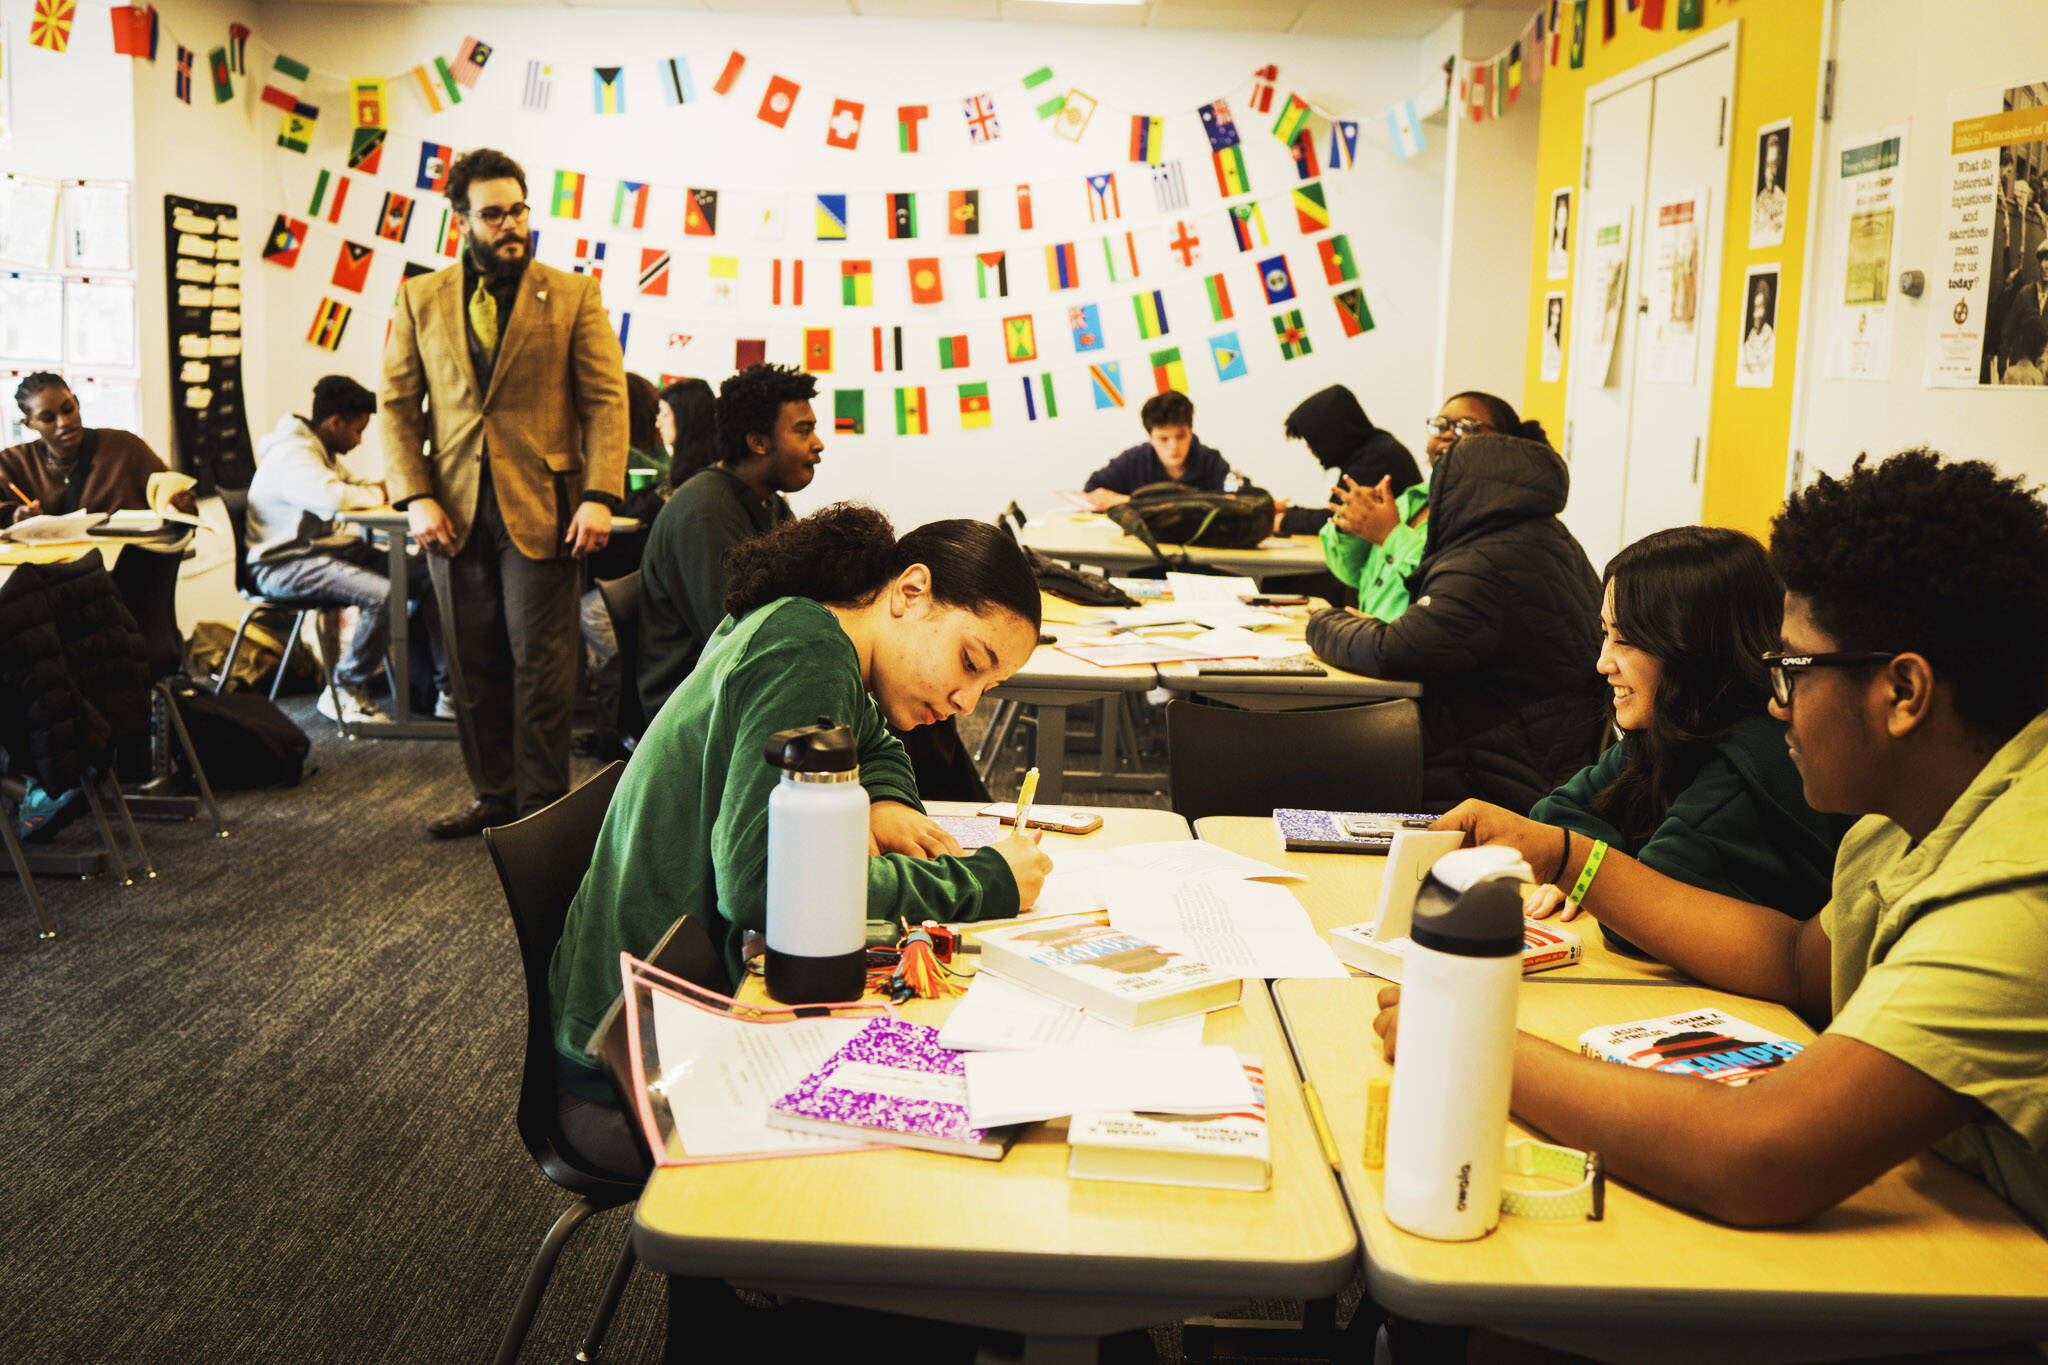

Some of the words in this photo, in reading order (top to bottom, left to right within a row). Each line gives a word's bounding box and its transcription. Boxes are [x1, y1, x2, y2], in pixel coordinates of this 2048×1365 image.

[1958, 160, 1978, 172] What
[1981, 158, 1991, 169] do
[1953, 174, 1992, 191] historical
[1951, 194, 1992, 210] injustices
[1962, 210, 1977, 222] and
[1948, 227, 1988, 241] sacrifices
[1954, 246, 1978, 257] mean
[1953, 261, 1965, 273] for
[1968, 262, 1977, 272] us
[1782, 657, 1813, 666] OAKLEY
[1608, 1029, 1668, 1045] REYNOLDS
[1609, 1026, 1647, 1037] JASON
[1456, 1163, 1471, 1212] owala
